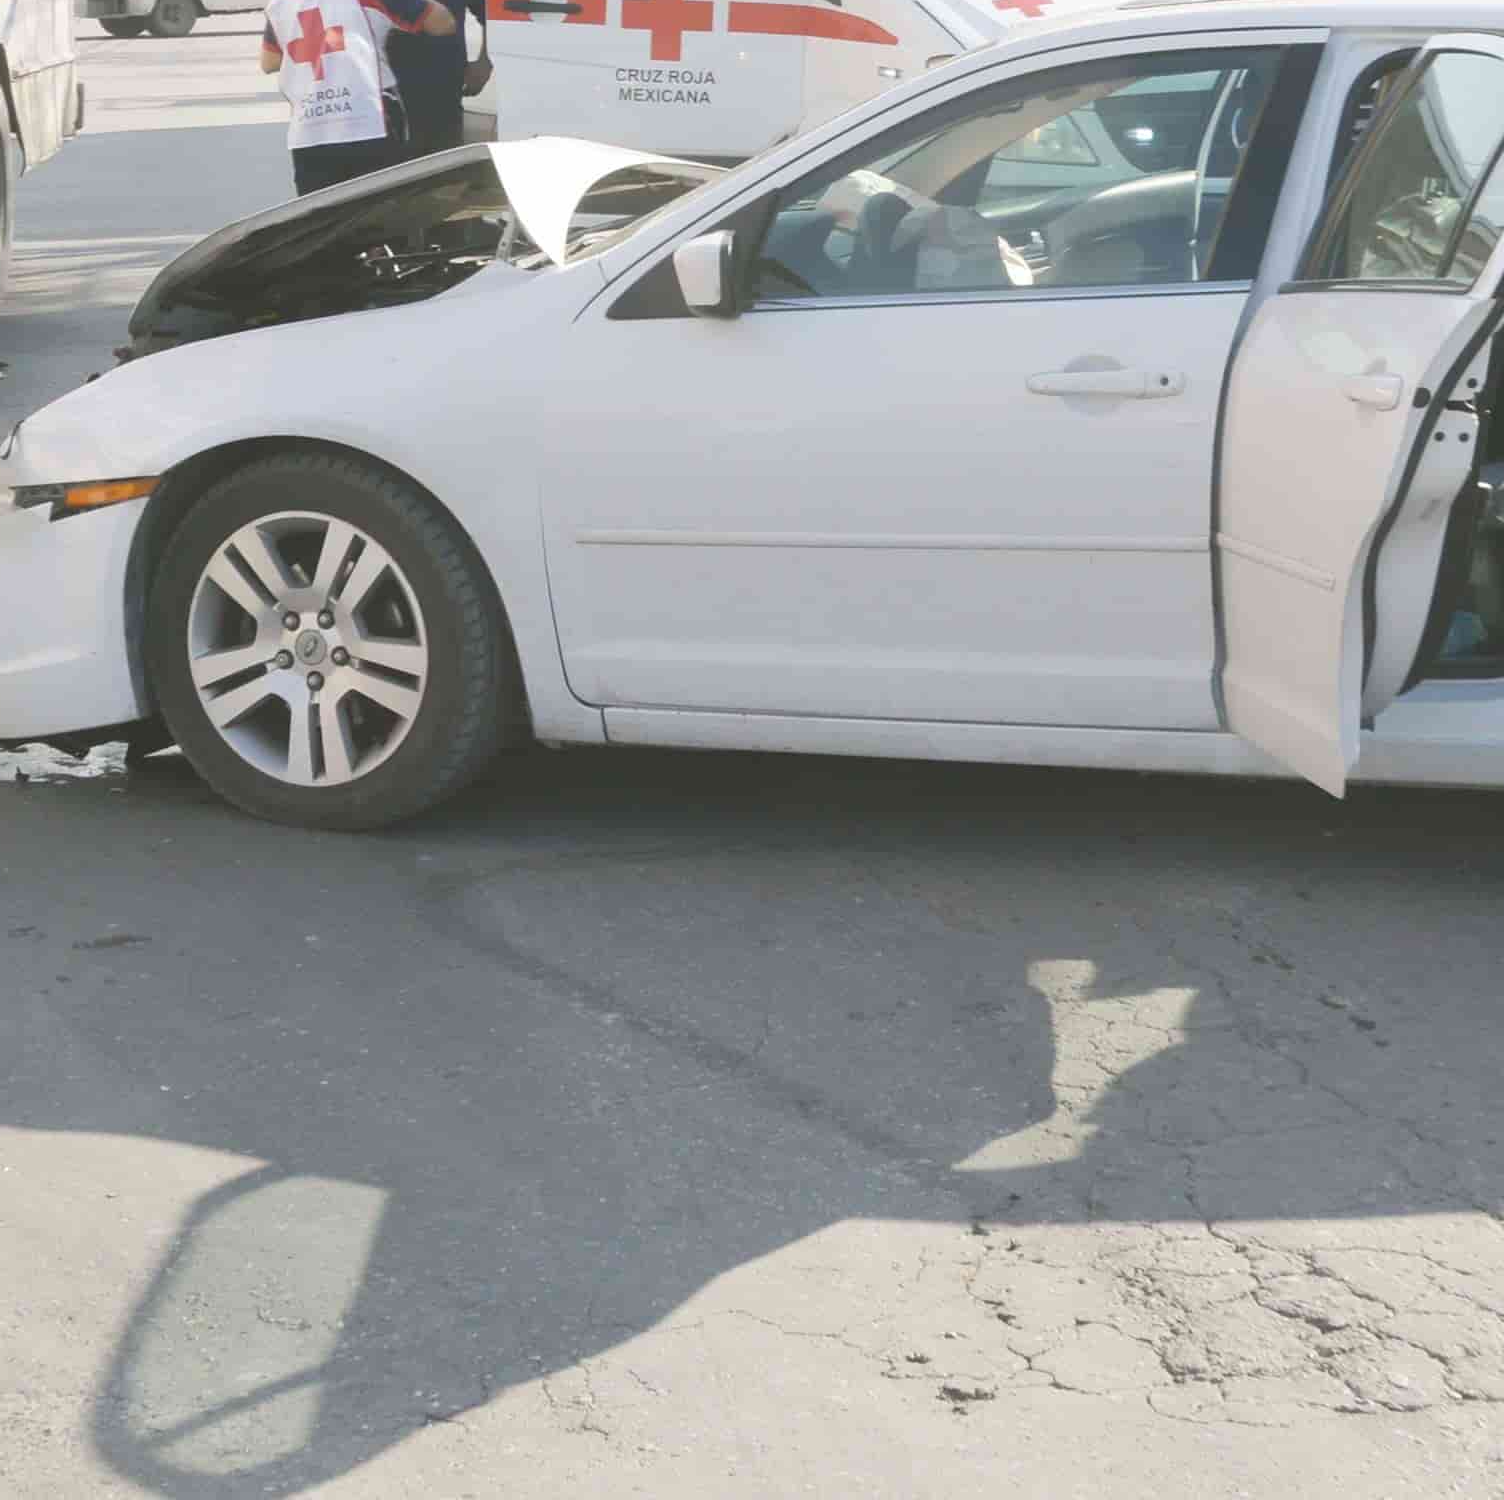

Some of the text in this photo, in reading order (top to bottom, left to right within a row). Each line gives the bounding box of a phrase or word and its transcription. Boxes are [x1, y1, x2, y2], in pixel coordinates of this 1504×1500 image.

[615, 67, 717, 85] CRUZ ROJA
[316, 86, 352, 101] ROJA
[618, 87, 711, 104] MEXICANA
